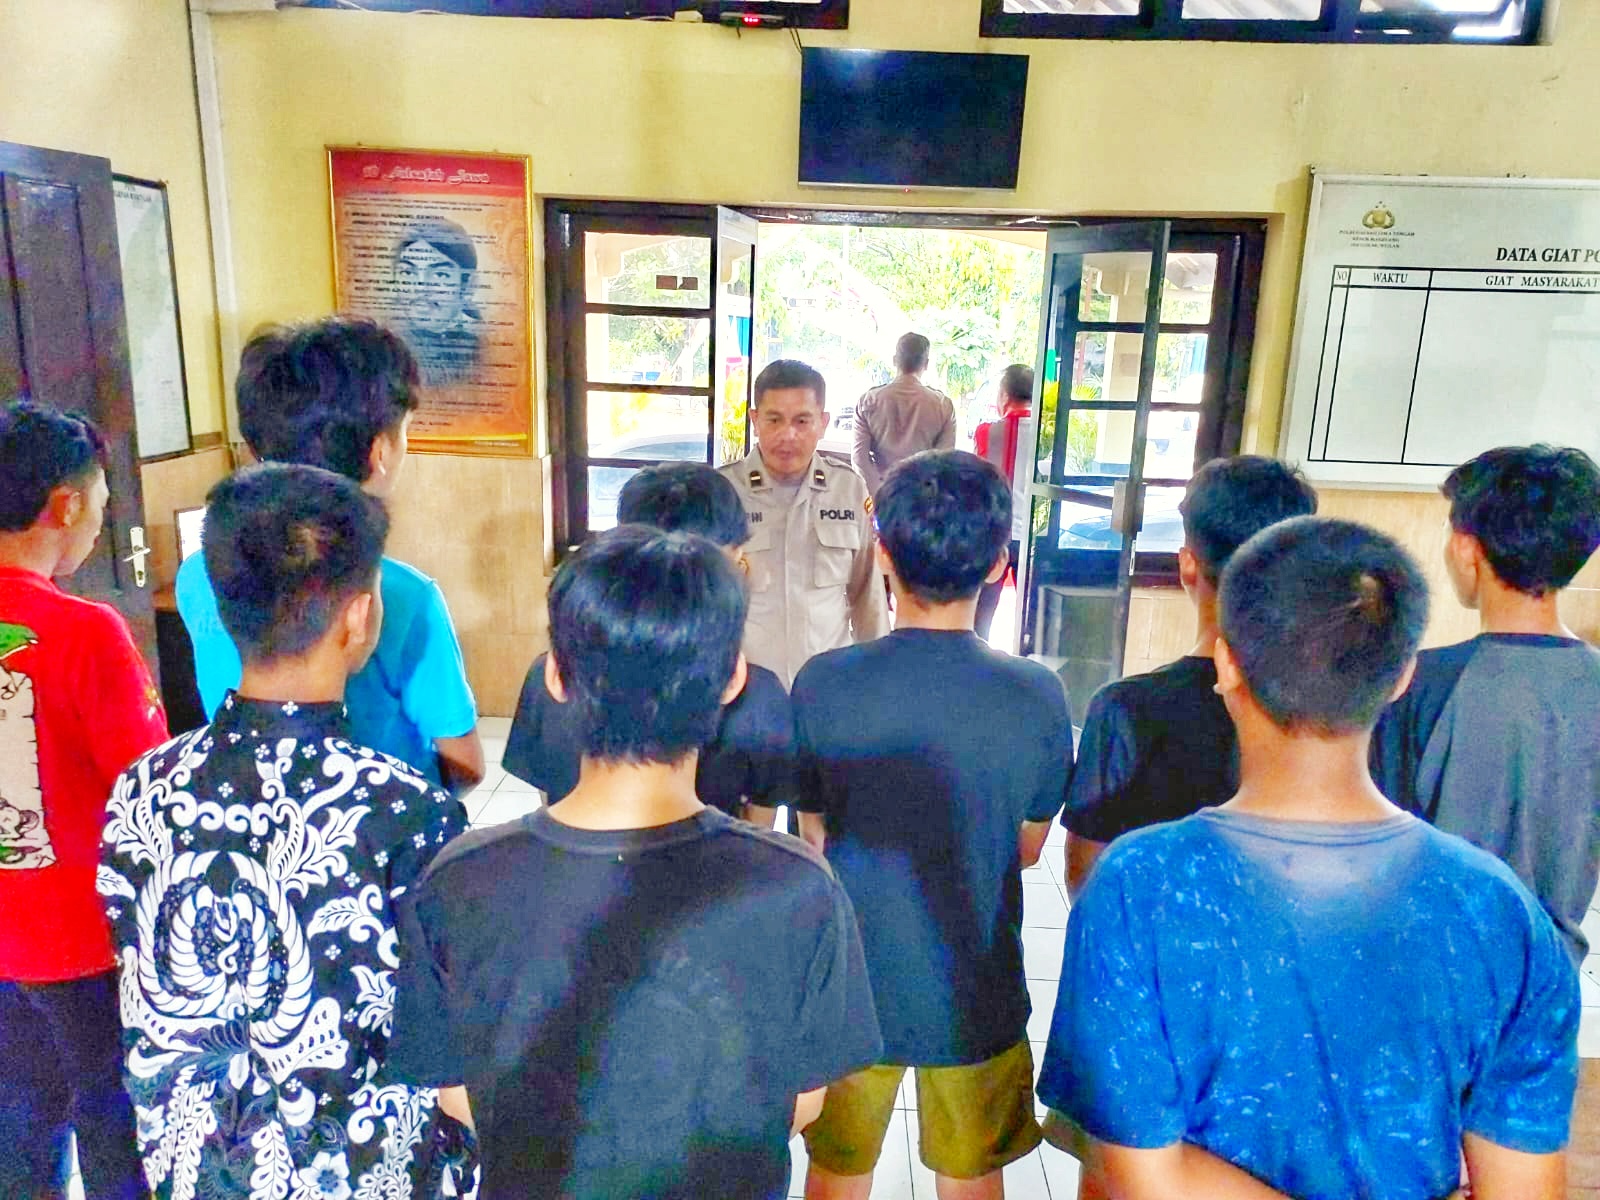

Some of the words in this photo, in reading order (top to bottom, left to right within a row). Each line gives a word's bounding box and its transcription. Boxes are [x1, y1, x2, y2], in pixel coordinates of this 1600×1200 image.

[1496, 247, 1537, 262] DATA
[1541, 248, 1581, 263] GIAT
[1336, 270, 1348, 281] NO
[1373, 272, 1409, 284] WAKTU
[1485, 275, 1514, 286] GIAT
[1520, 276, 1600, 288] MASYARAKAT
[819, 509, 855, 520] POLRI
